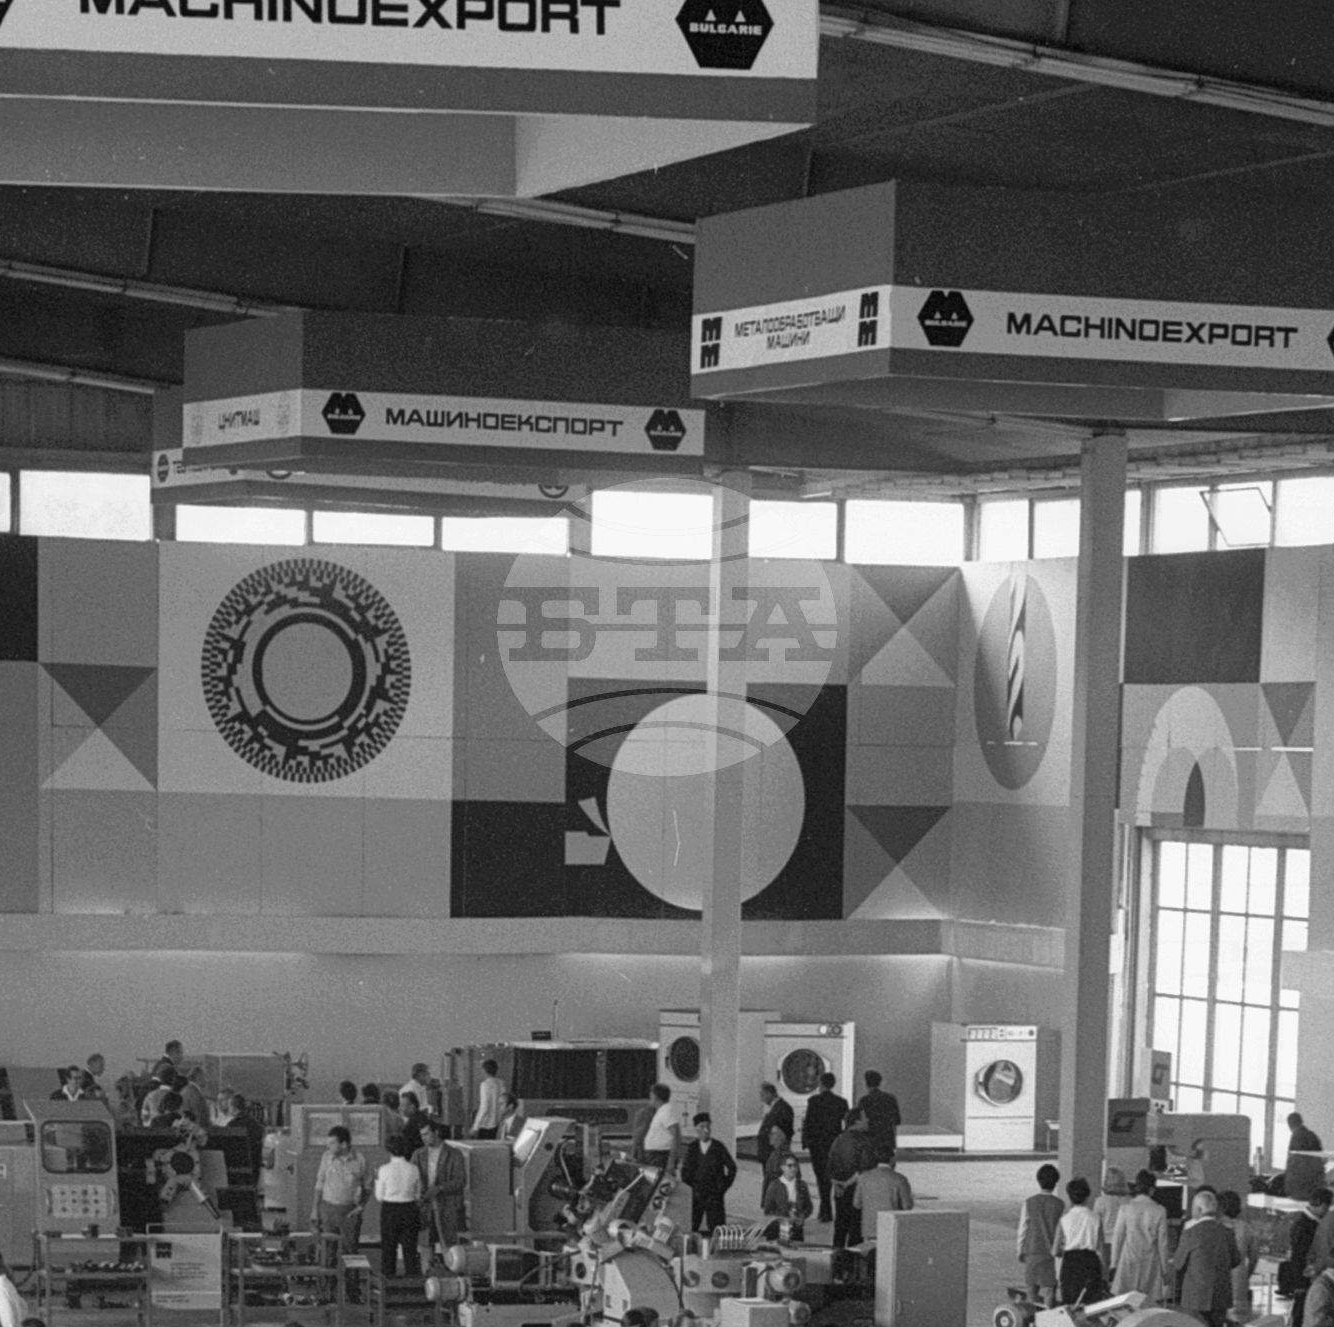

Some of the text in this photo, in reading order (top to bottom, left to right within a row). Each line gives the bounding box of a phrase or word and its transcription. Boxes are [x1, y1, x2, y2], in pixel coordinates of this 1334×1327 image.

[687, 21, 763, 36] BULGARIE
[1005, 311, 1299, 350] MACHINOEXPORT
[385, 407, 624, 438] МАШИНОЕКСПОРТ
